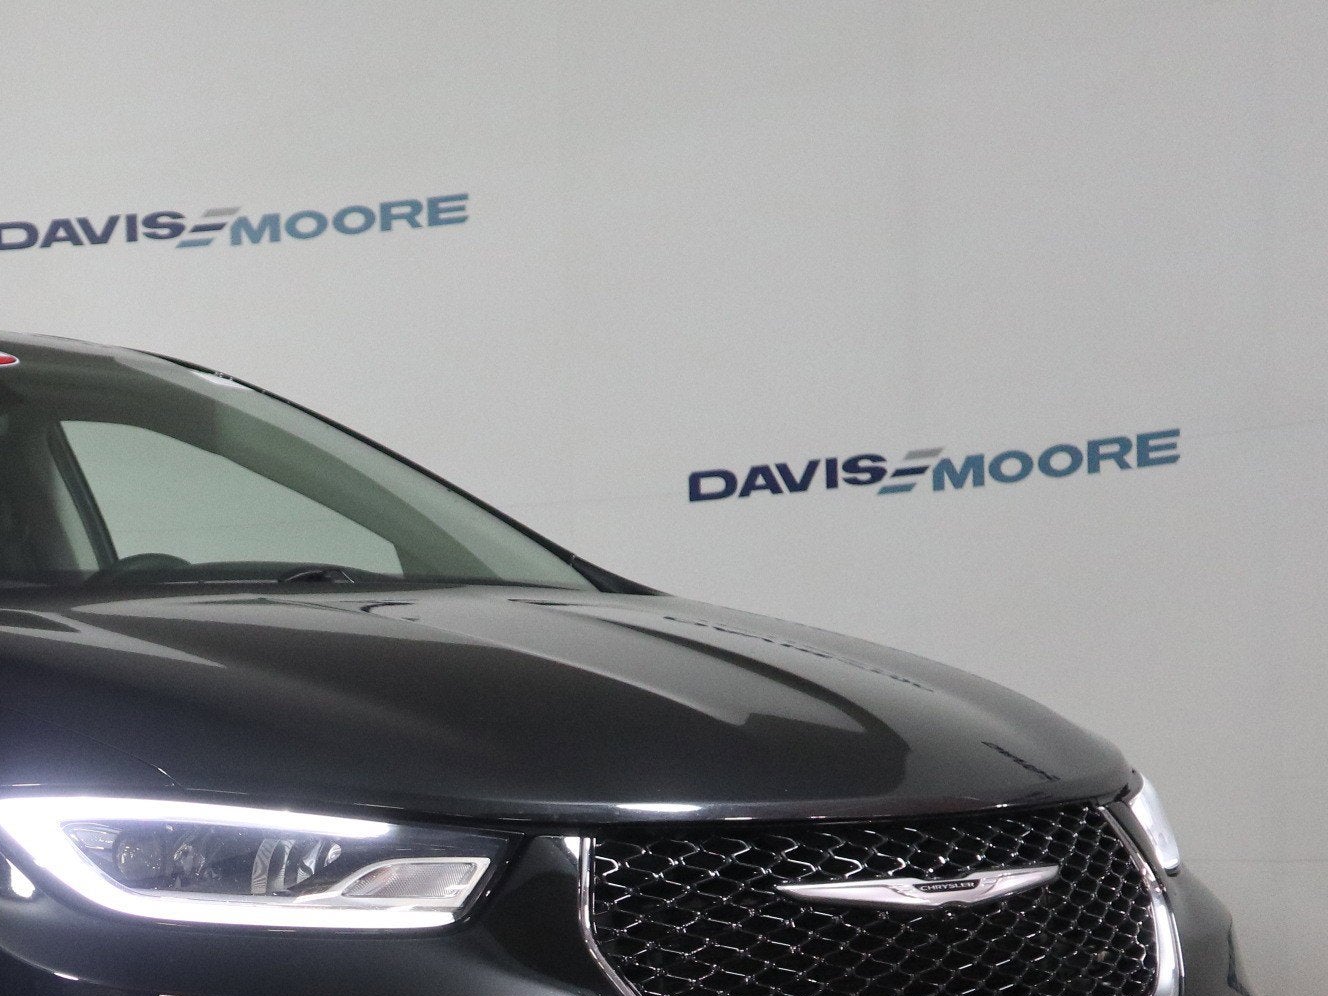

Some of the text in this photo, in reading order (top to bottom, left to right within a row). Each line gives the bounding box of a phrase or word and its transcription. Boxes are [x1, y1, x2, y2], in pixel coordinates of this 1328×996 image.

[229, 193, 470, 247] MOORE
[688, 428, 1181, 502] DAVIS MOORE
